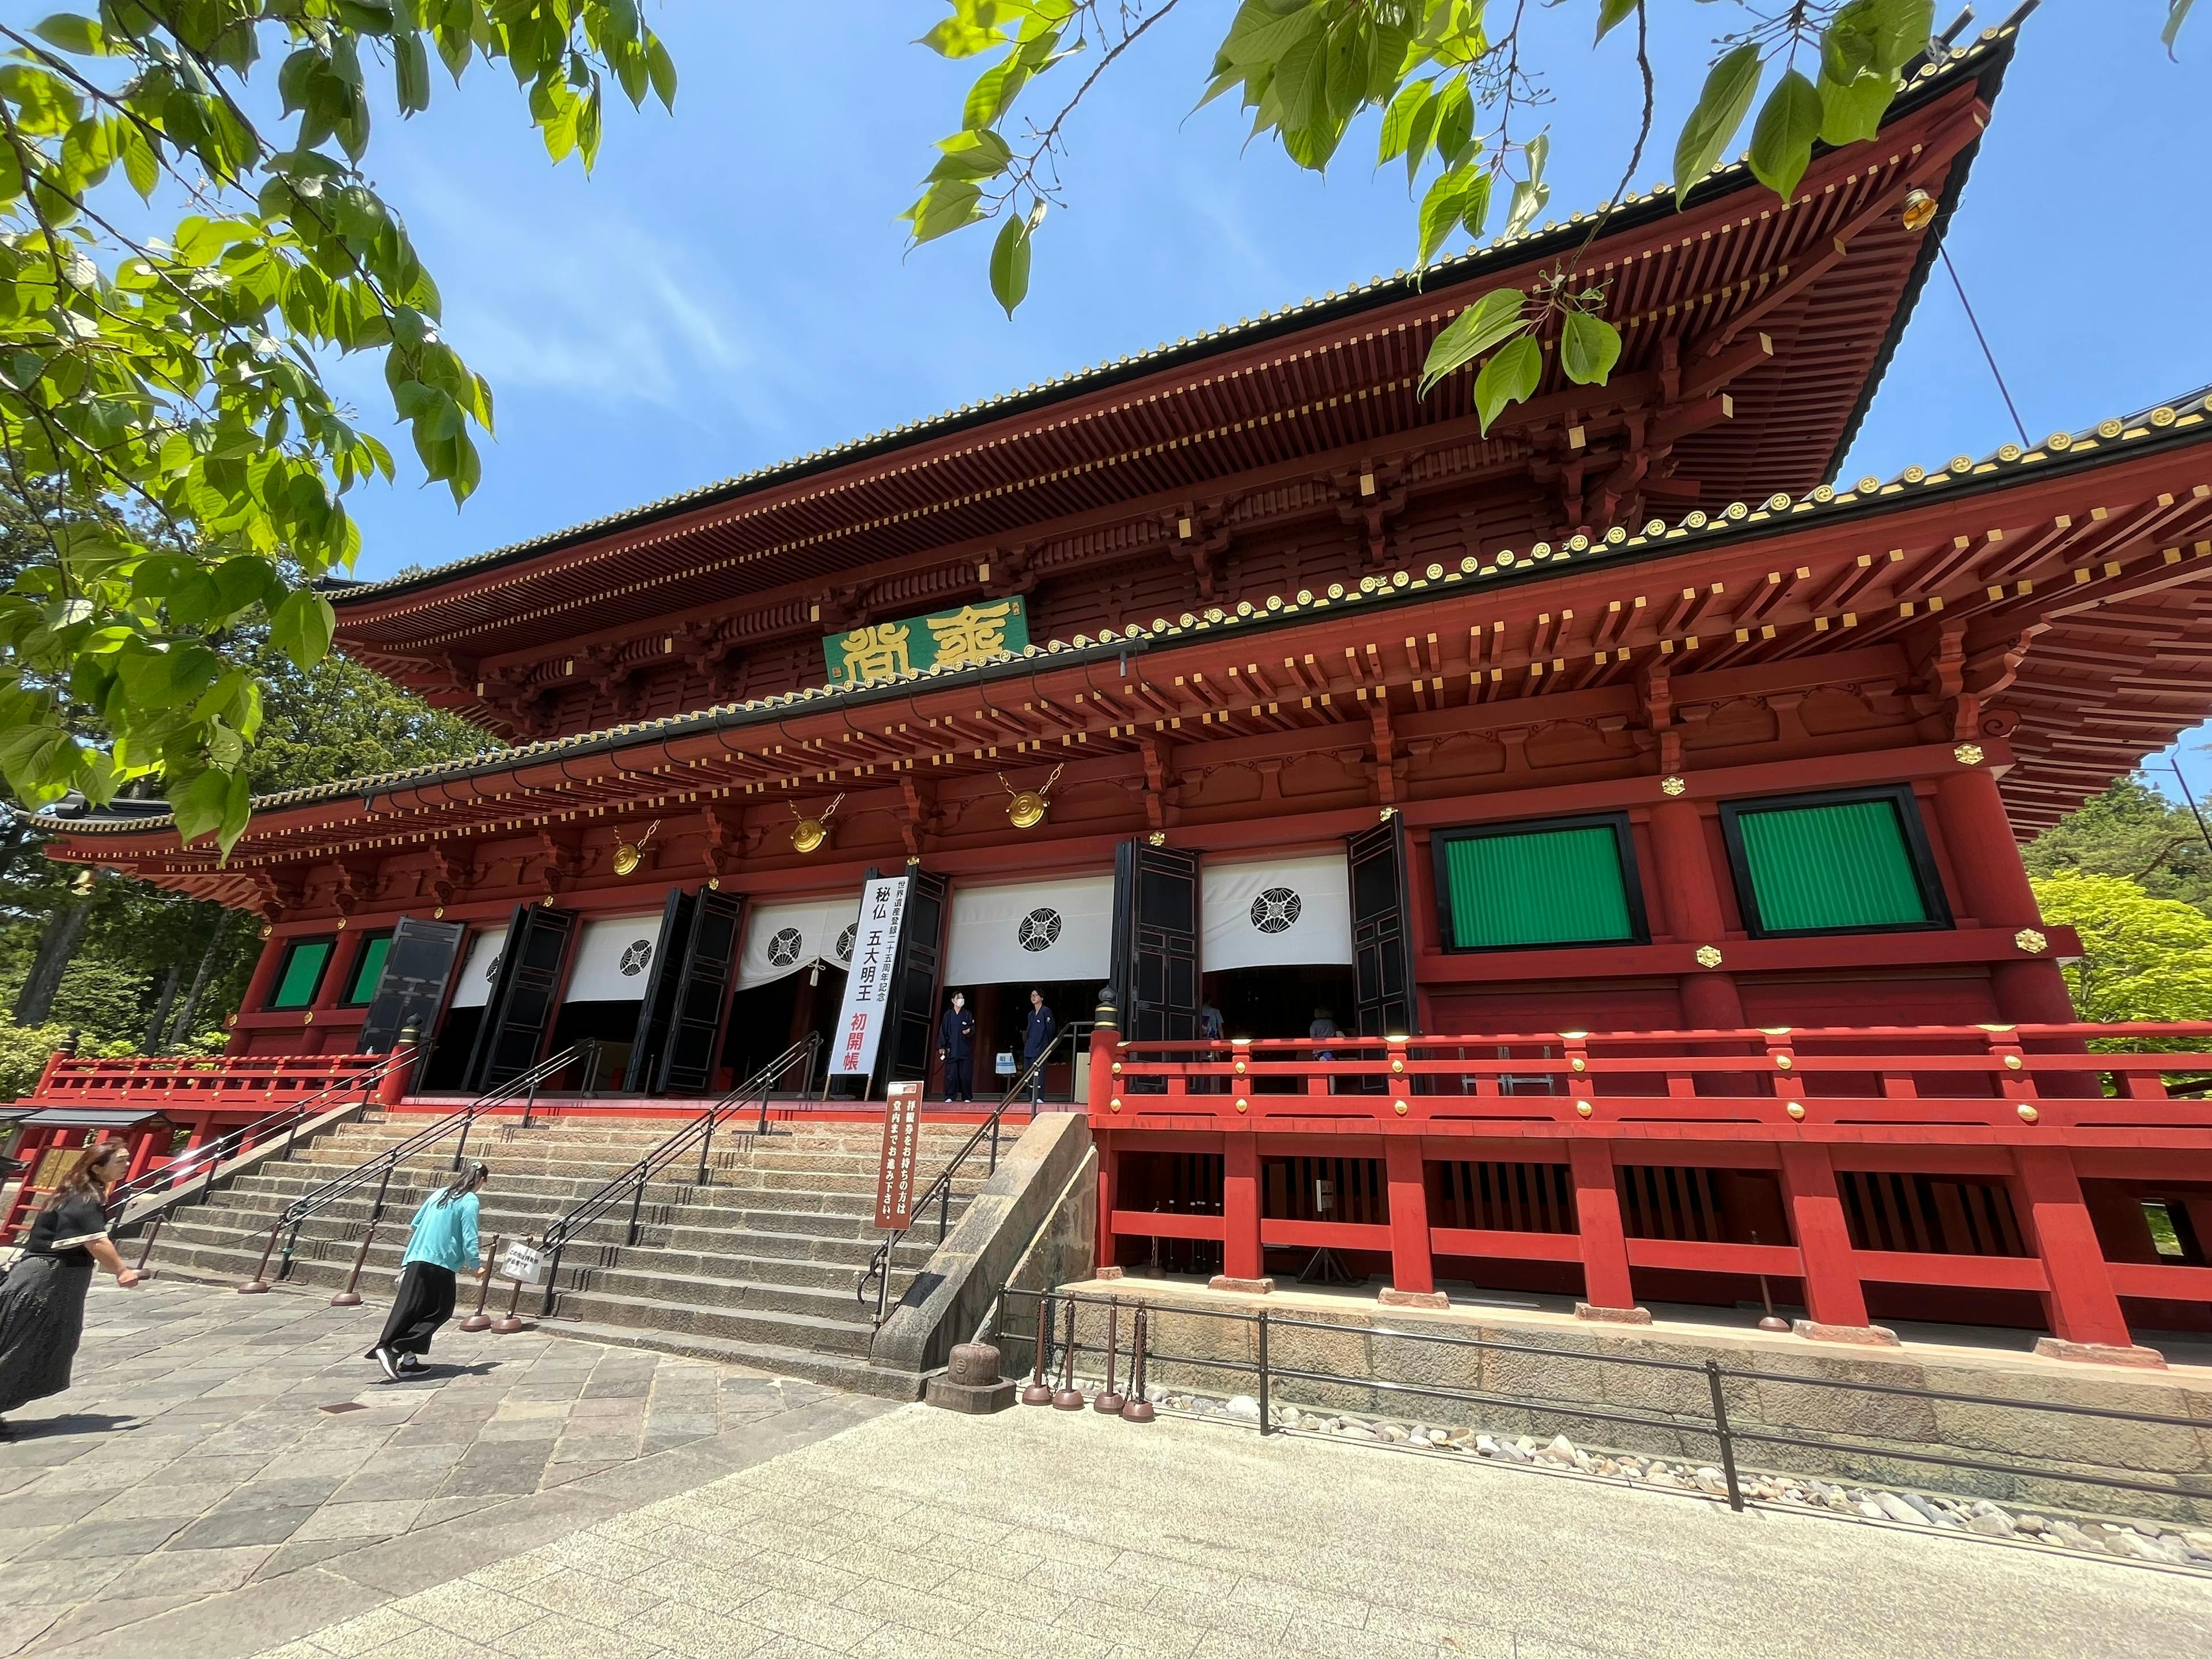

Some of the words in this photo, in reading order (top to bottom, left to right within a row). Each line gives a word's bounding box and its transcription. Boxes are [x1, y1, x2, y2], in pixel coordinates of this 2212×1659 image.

[872, 887, 891, 921] 秘仏
[856, 930, 883, 1002] 五大明王
[876, 880, 906, 1002] 世界遺産登録二十五周年記念
[843, 1013, 868, 1071] 初開帳
[896, 1100, 916, 1214] 拝観券をお持ちの方は
